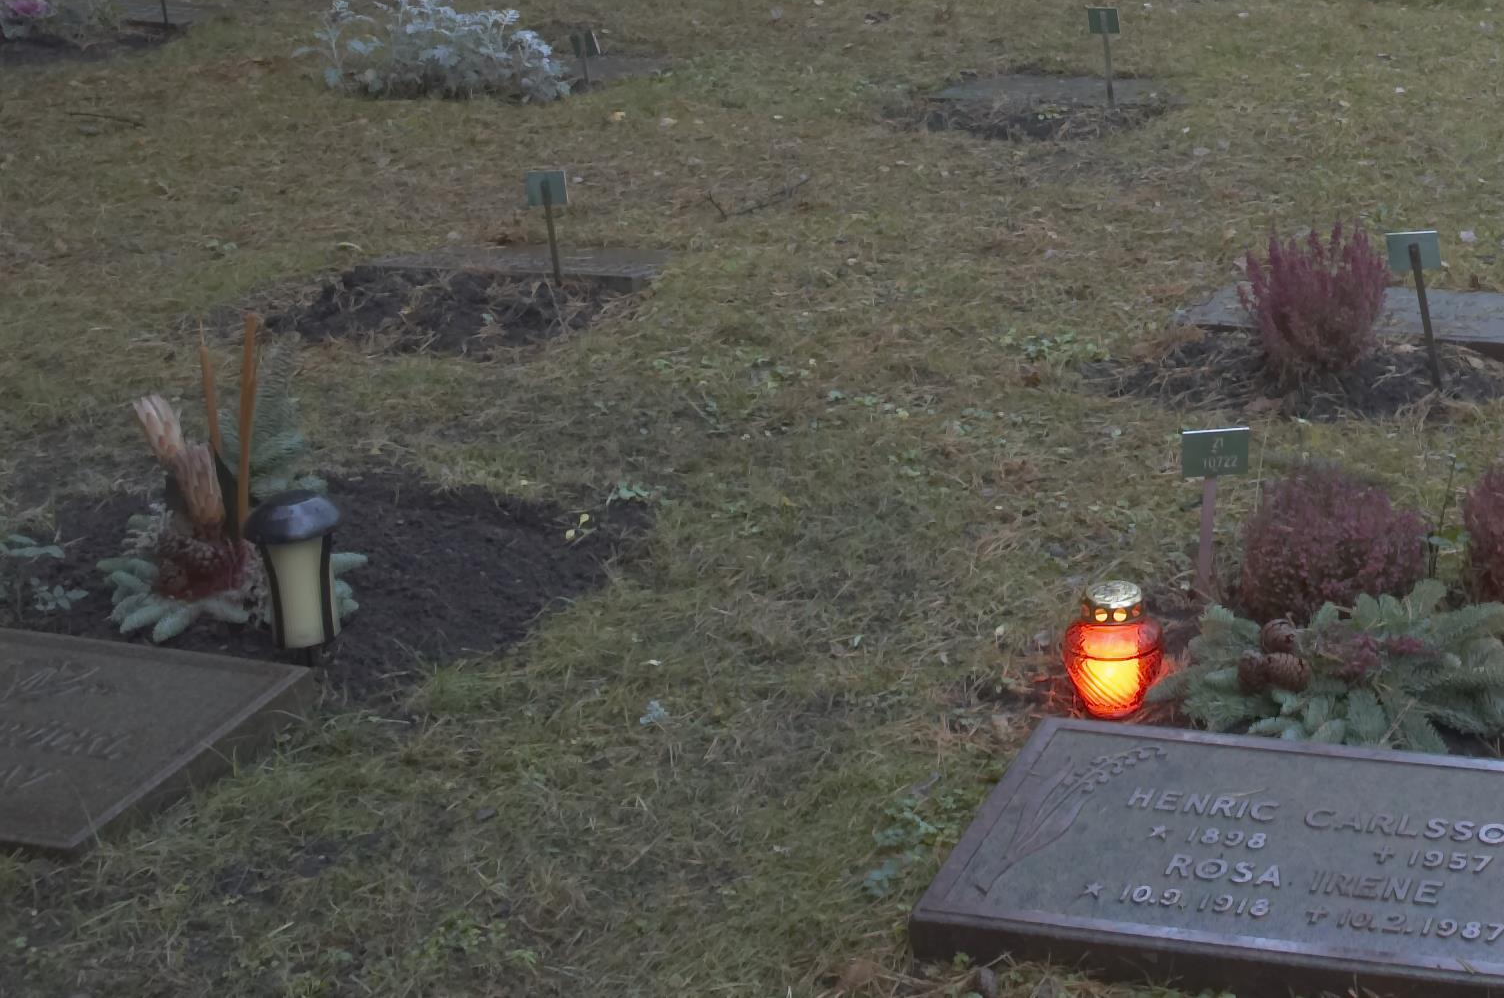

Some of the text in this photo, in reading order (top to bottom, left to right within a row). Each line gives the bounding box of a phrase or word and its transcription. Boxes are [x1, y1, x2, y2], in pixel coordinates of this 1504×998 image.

[1127, 787, 1281, 822] HENRIC
[1185, 825, 1494, 875] 1898 1957
[1164, 853, 1445, 906] ROSA IRENE
